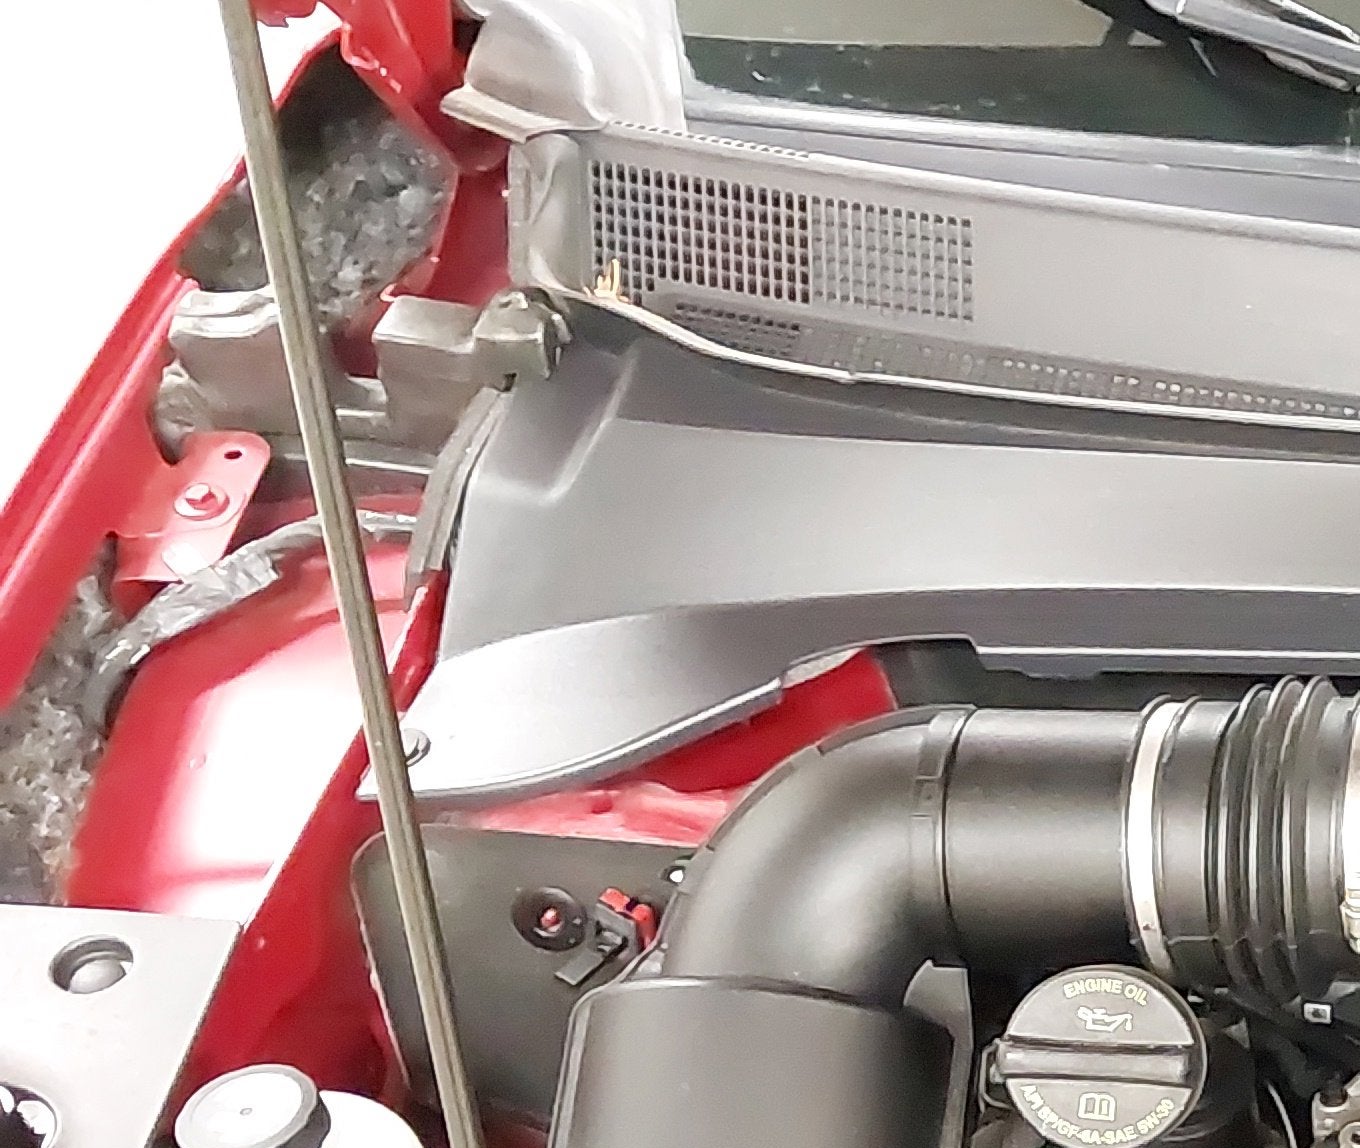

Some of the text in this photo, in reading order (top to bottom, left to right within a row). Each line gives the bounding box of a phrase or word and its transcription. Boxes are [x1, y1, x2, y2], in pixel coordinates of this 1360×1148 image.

[1063, 978, 1149, 1006] ENGINE OIL
[1136, 1098, 1175, 1135] 5W-30
